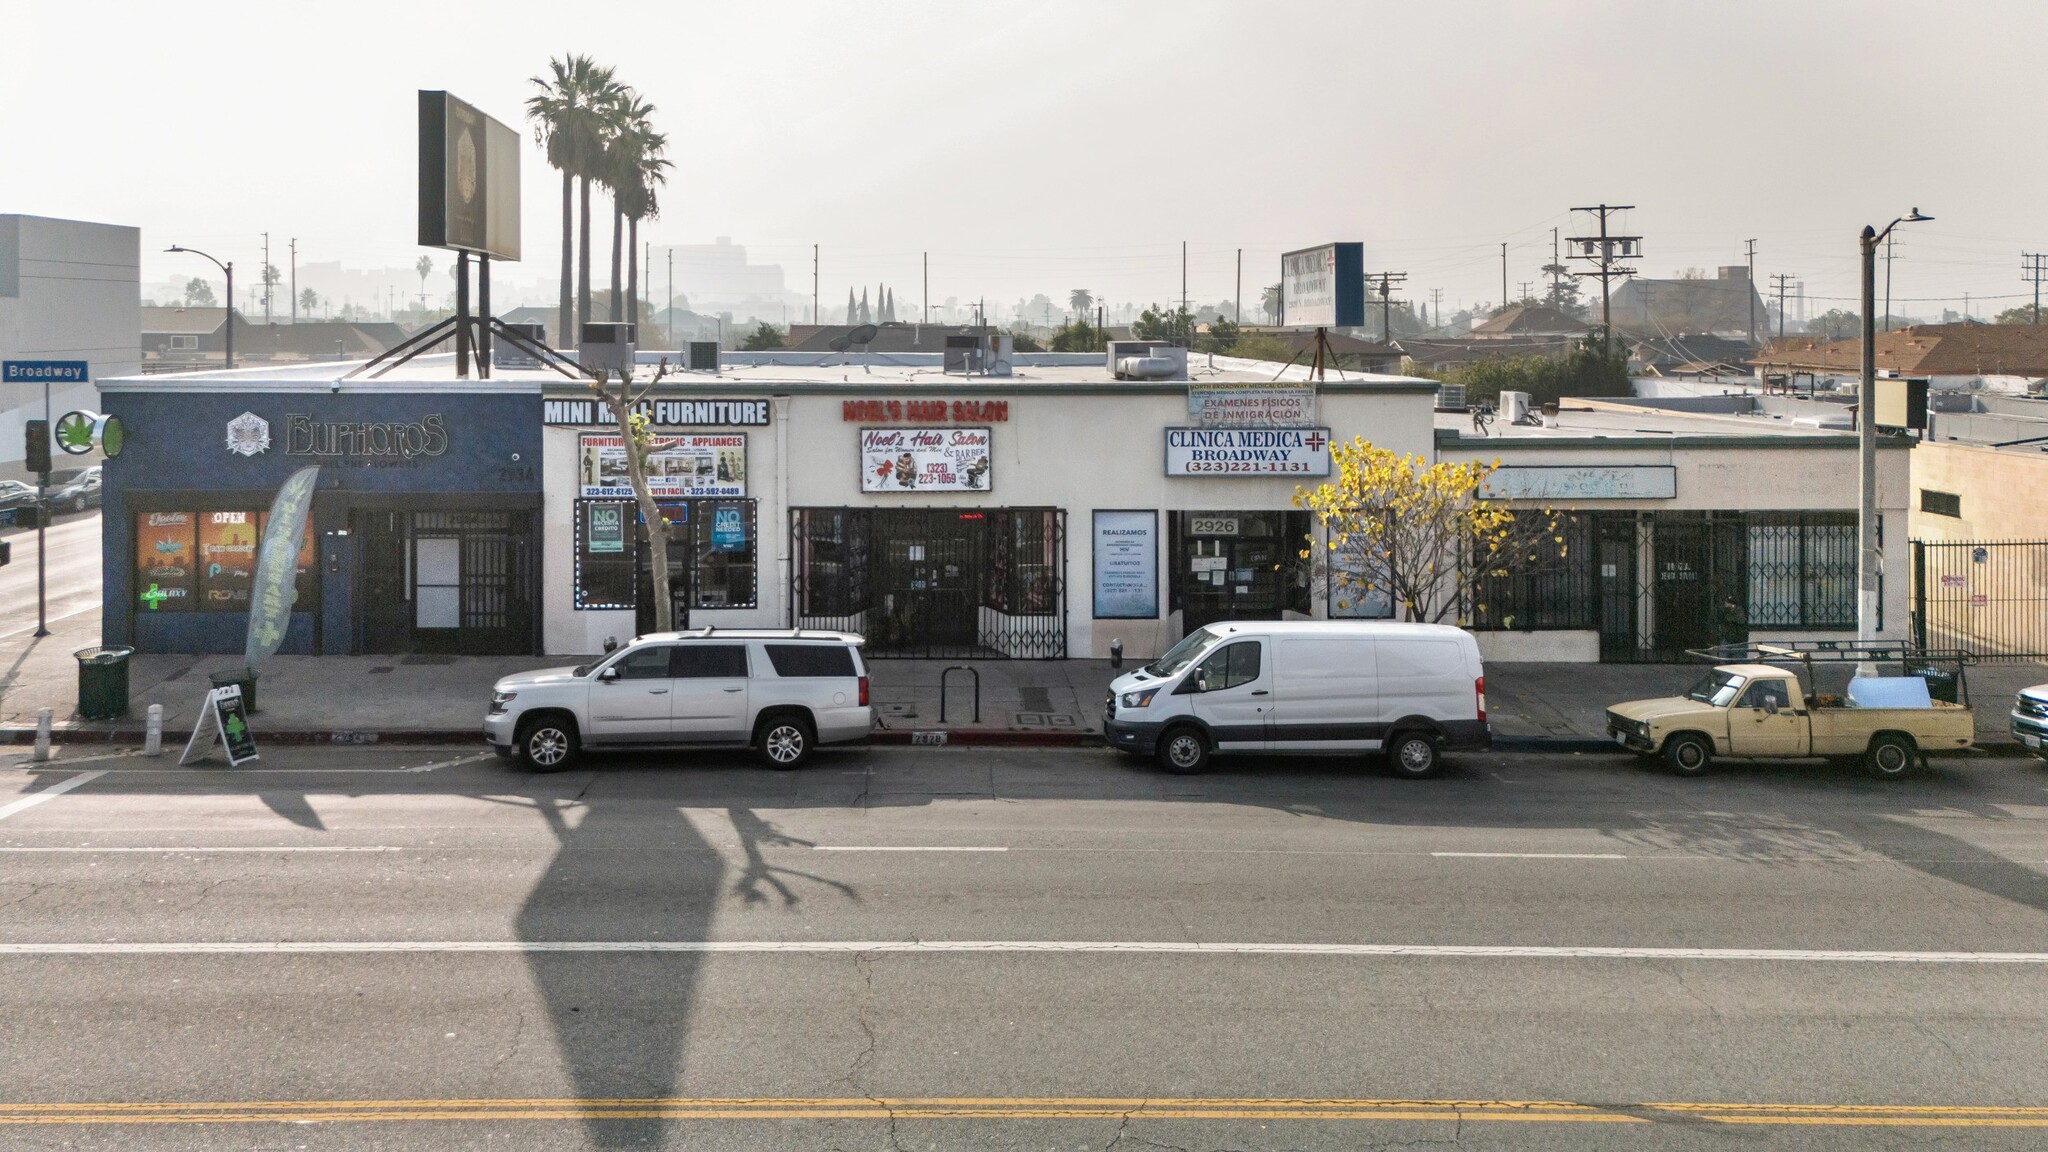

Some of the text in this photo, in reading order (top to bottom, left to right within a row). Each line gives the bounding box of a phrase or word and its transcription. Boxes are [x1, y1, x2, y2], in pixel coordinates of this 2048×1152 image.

[1293, 278, 1326, 294] BROADWAY
[9, 365, 82, 379] Broadway
[544, 401, 591, 423] MINI
[656, 401, 767, 424] FURNITURE
[843, 400, 1008, 422] NOEL'S HAIR SALON
[286, 413, 448, 458] EUPHOROS
[864, 431, 988, 447] Noel's Hair Salon
[1169, 431, 1303, 448] CLINICA MEDICA
[582, 437, 625, 447] FURNITUR
[692, 437, 743, 447] APPLIANCES
[885, 446, 893, 454] for
[944, 447, 985, 461] & BARBER
[1191, 449, 1291, 461] BROADWAY
[927, 463, 947, 473] (323)
[1185, 461, 1311, 473] (323)221-1131
[918, 473, 956, 484] 223-1059
[586, 487, 633, 495] 323-612-6125
[667, 488, 685, 496] FACIL
[691, 487, 739, 495] 323-592-0489
[212, 512, 246, 524] OPEN
[594, 510, 618, 522] NO
[716, 510, 740, 522] NO
[1195, 520, 1235, 532] 2926
